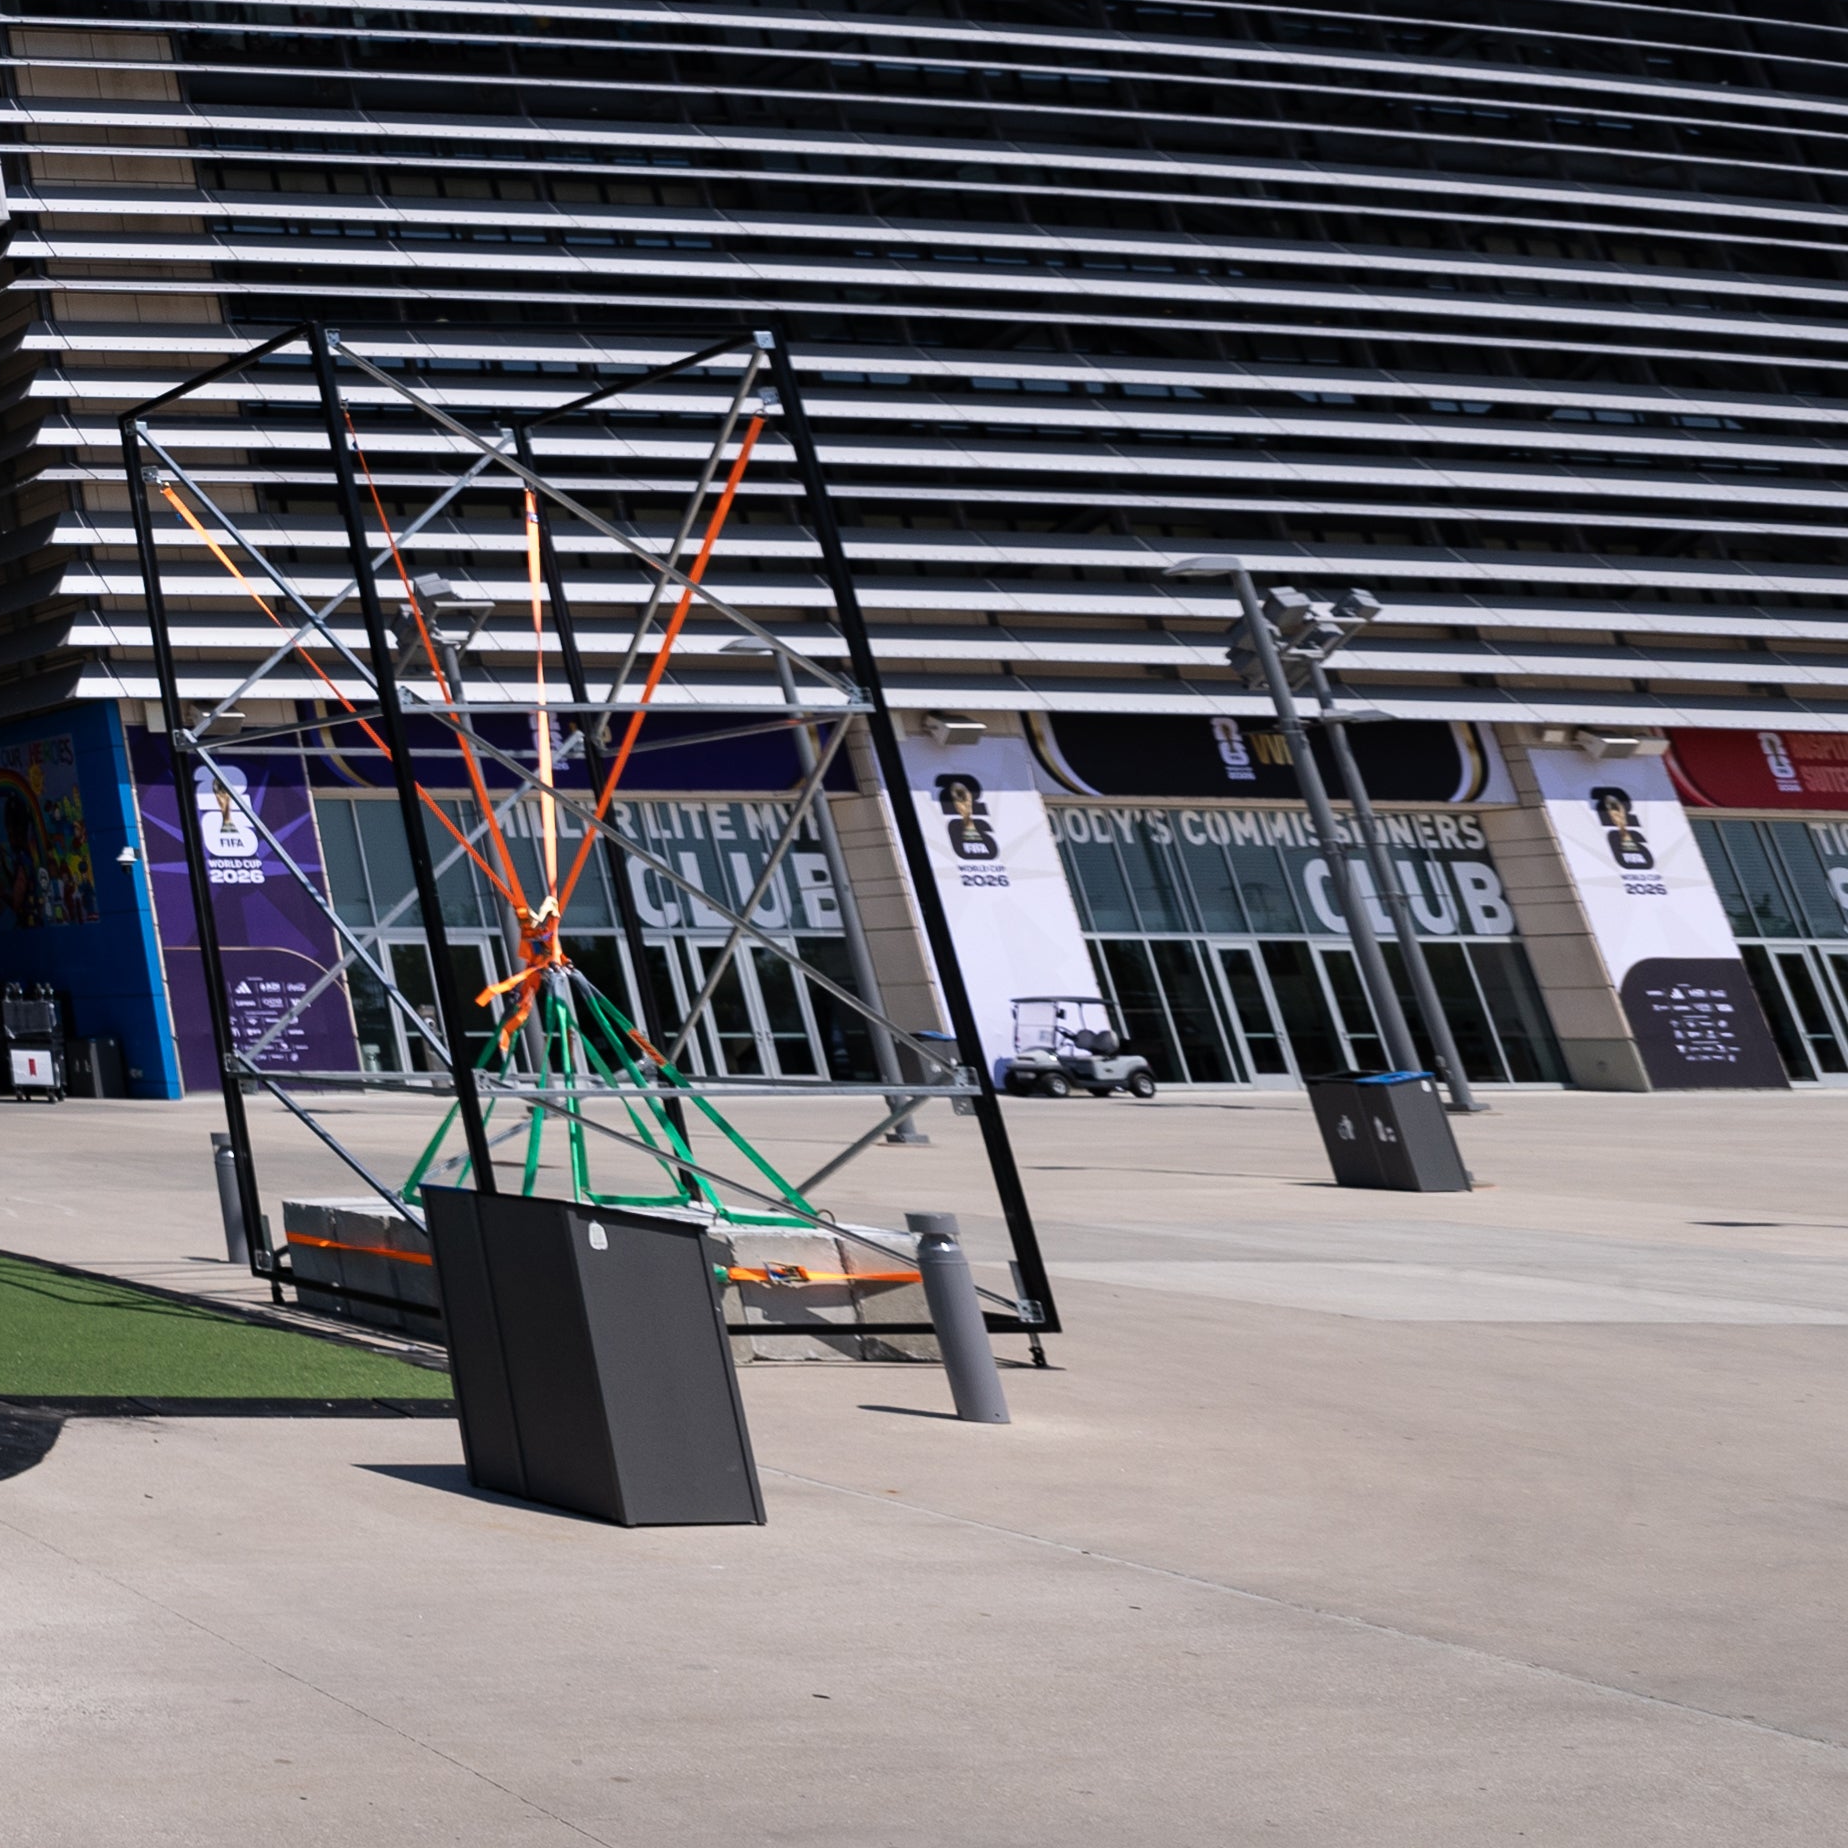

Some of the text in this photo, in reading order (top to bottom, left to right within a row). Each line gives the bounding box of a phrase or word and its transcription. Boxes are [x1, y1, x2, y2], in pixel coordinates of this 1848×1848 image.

[0, 747, 23, 767] OUR
[28, 738, 73, 765] HEROES
[647, 801, 737, 841] LITE
[219, 837, 245, 848] FIFA
[962, 842, 989, 854] FIFA
[208, 859, 262, 868] WORLD CUP
[210, 869, 265, 884] 2026
[961, 875, 1010, 887] 2026
[626, 853, 846, 929] CLUB
[1623, 883, 1668, 895] 2026
[1302, 857, 1516, 935] CLUB
